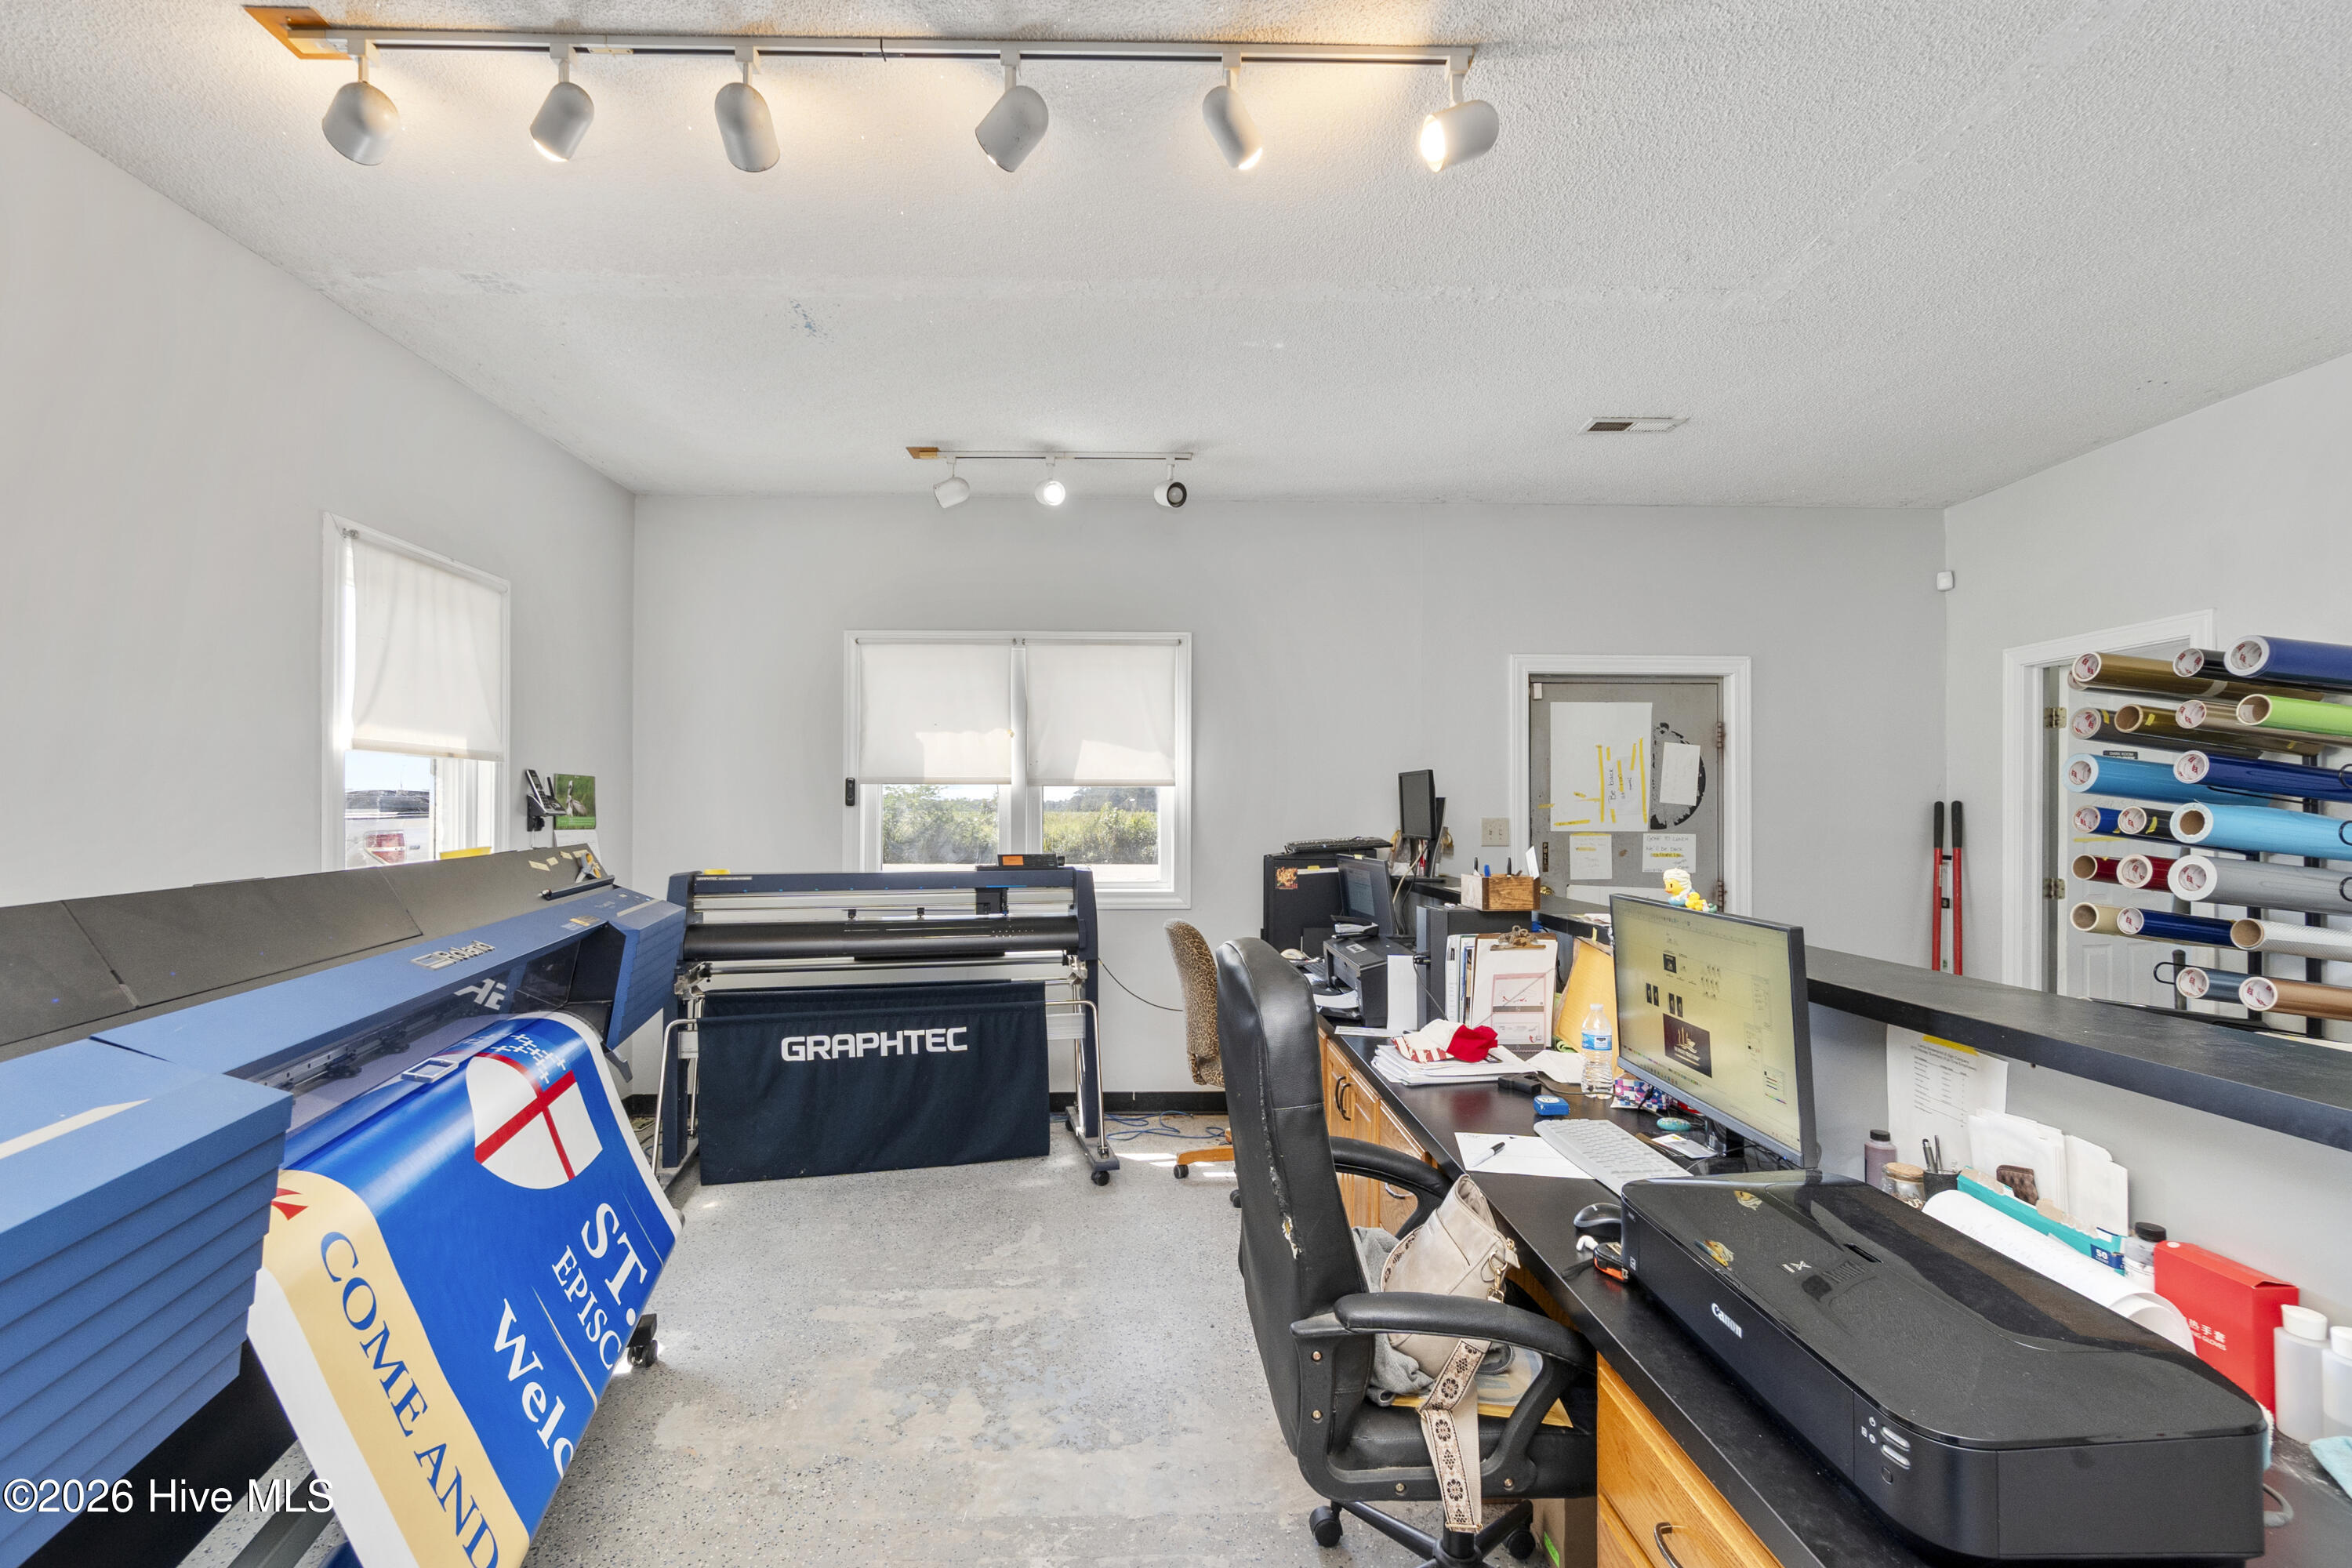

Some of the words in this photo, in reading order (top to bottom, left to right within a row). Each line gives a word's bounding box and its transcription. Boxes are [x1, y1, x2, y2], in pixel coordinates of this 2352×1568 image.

[1606, 769, 1615, 786] back
[432, 939, 496, 965] Roland
[780, 1026, 968, 1062] GRAPHTEC
[581, 1203, 648, 1327] ST.
[551, 1245, 622, 1370] EPISC
[1711, 1302, 1743, 1339] Canon
[320, 1231, 428, 1437] COME
[413, 1443, 499, 1568] AND
